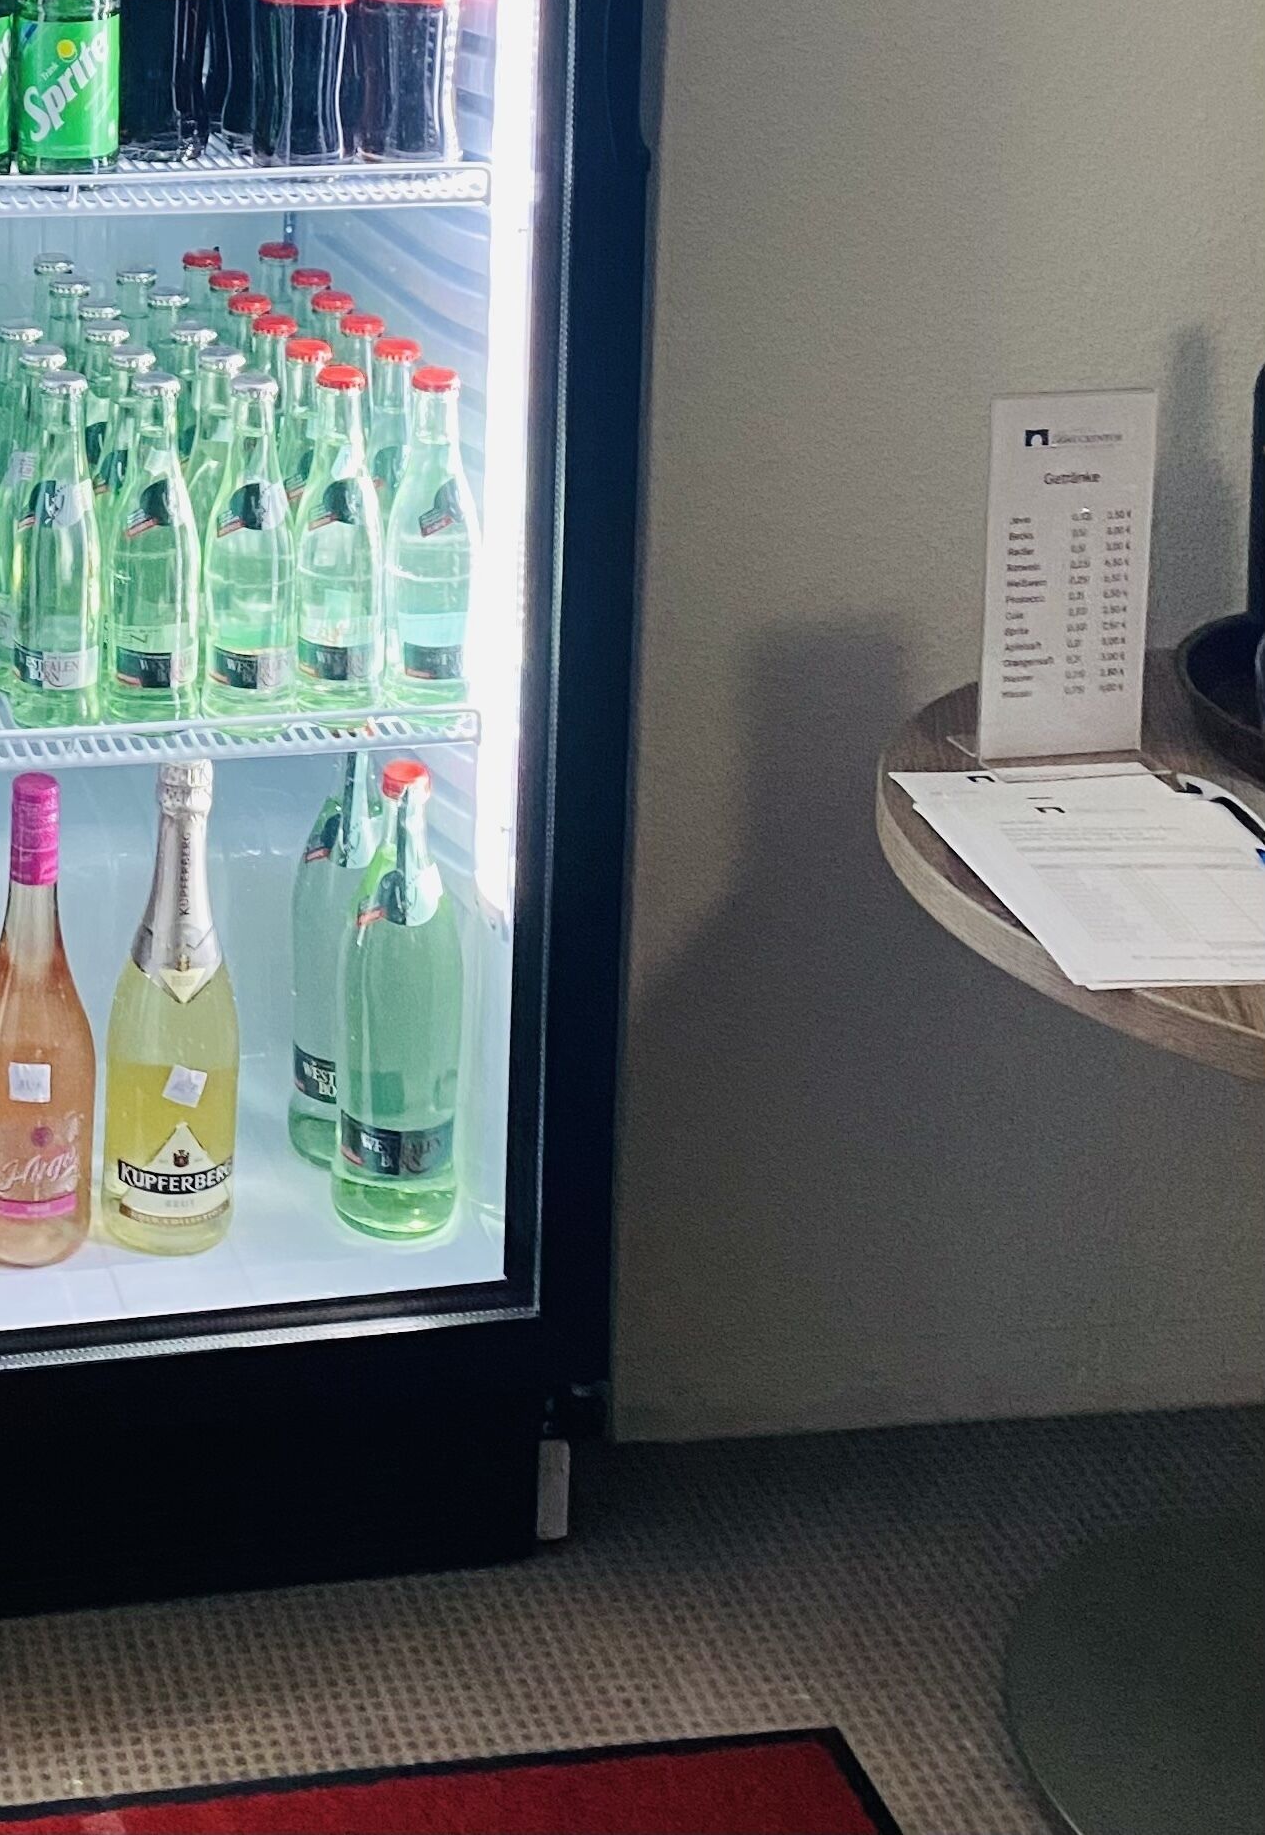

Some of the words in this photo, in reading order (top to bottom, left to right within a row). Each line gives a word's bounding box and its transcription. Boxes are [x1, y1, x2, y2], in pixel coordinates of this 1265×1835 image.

[23, 31, 109, 143] Sprite
[178, 831, 192, 916] KUPFERBERG
[120, 1156, 233, 1193] KUPFERBERG
